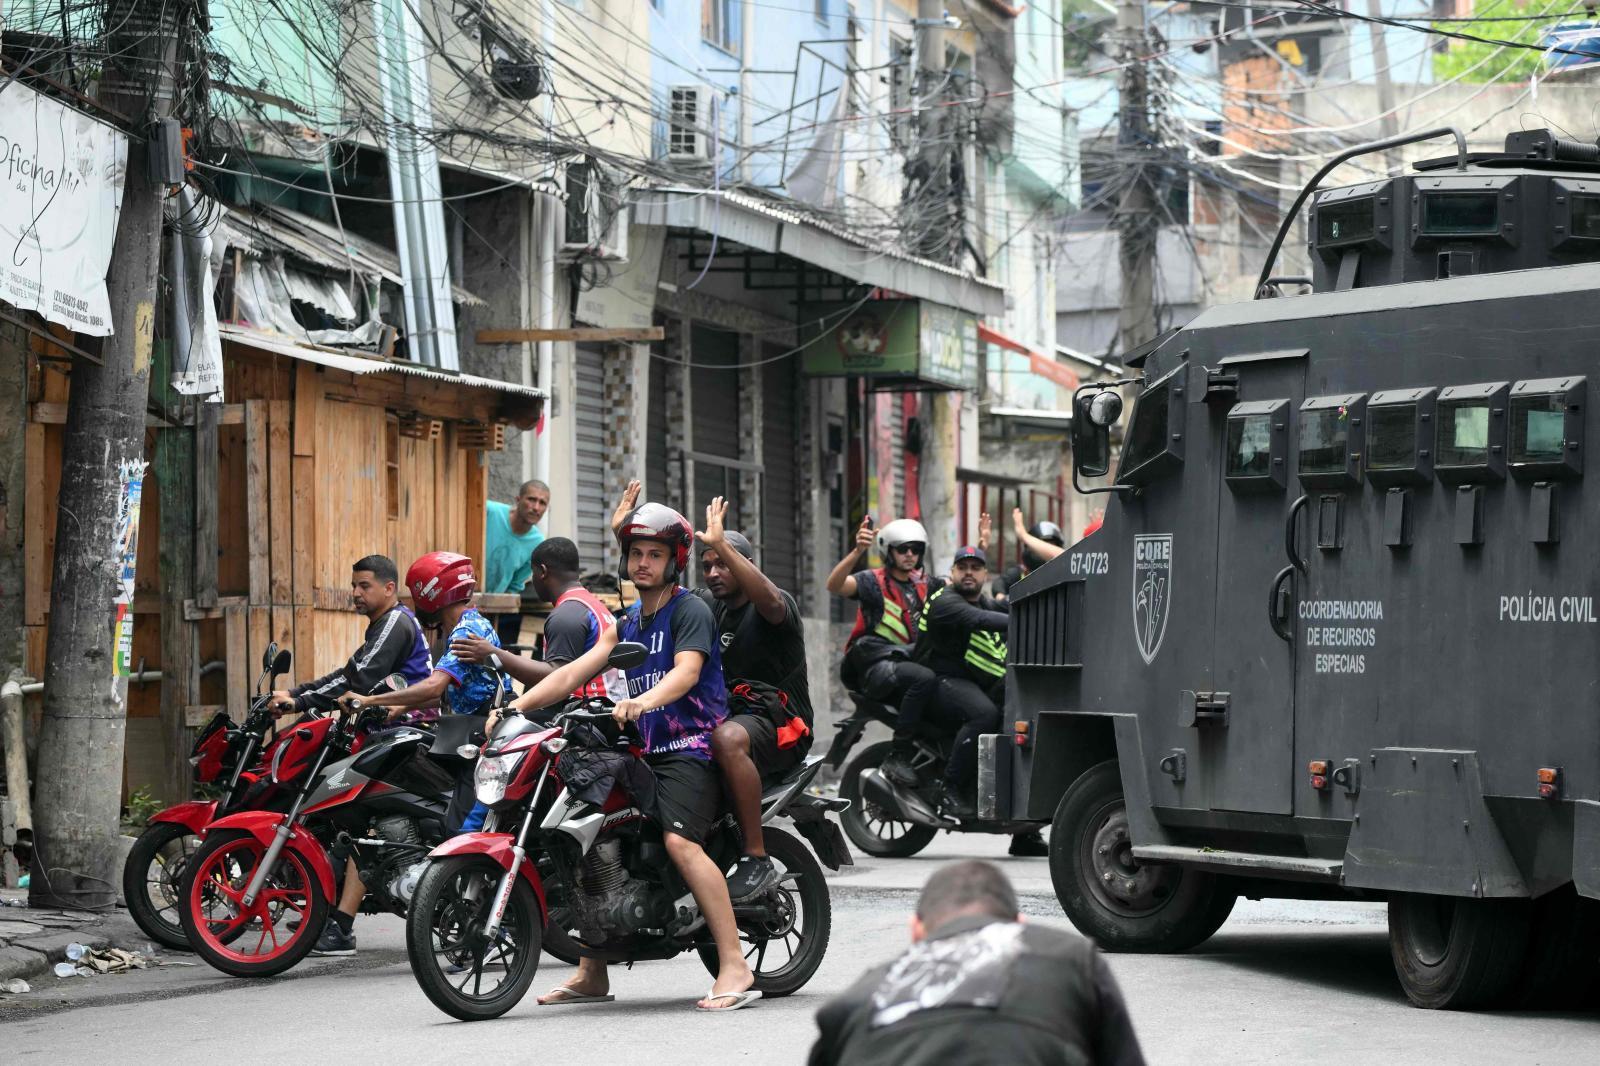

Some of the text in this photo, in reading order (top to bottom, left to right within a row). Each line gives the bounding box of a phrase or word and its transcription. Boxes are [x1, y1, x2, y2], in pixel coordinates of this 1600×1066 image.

[1136, 541, 1170, 561] CORE
[1070, 551, 1109, 575] 67-0723
[1299, 600, 1384, 620] COORDENADORIA
[1499, 589, 1598, 623] POLÍCIA CIVIL
[1307, 627, 1376, 647] DE RECURSOS
[1315, 653, 1366, 674] ESPECIAIS
